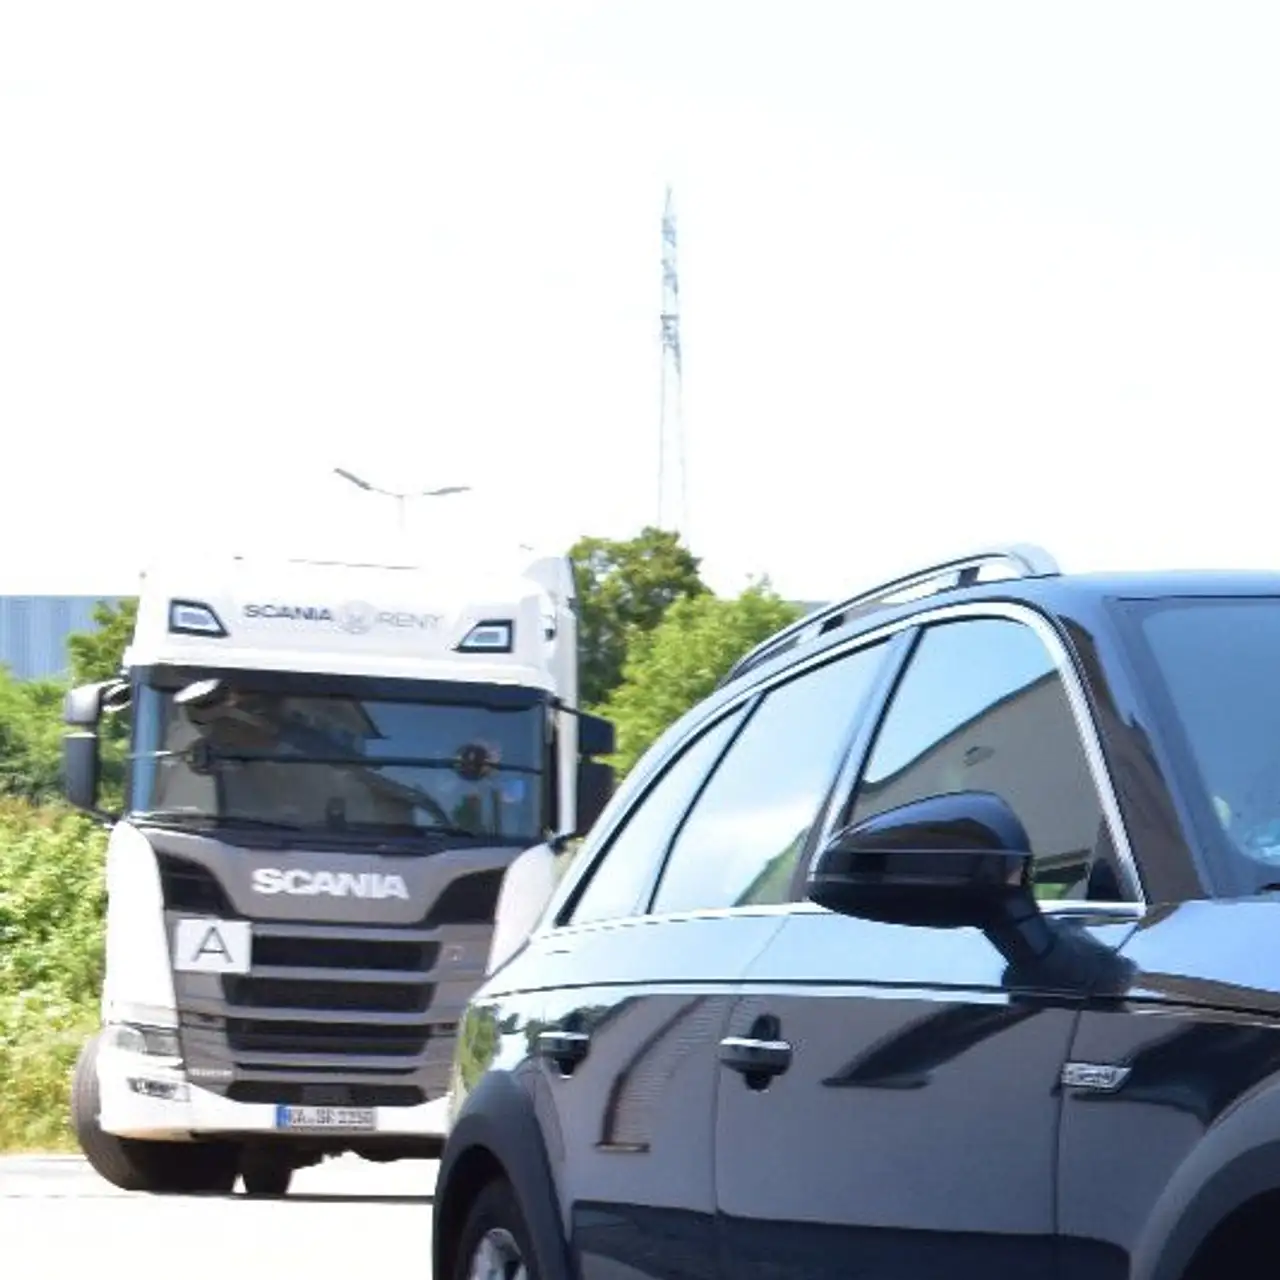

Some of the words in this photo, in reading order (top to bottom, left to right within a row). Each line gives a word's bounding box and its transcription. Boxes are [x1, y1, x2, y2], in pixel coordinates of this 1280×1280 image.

[243, 604, 333, 621] SCANIA
[252, 868, 409, 899] SCANIA
[190, 926, 234, 964] A
